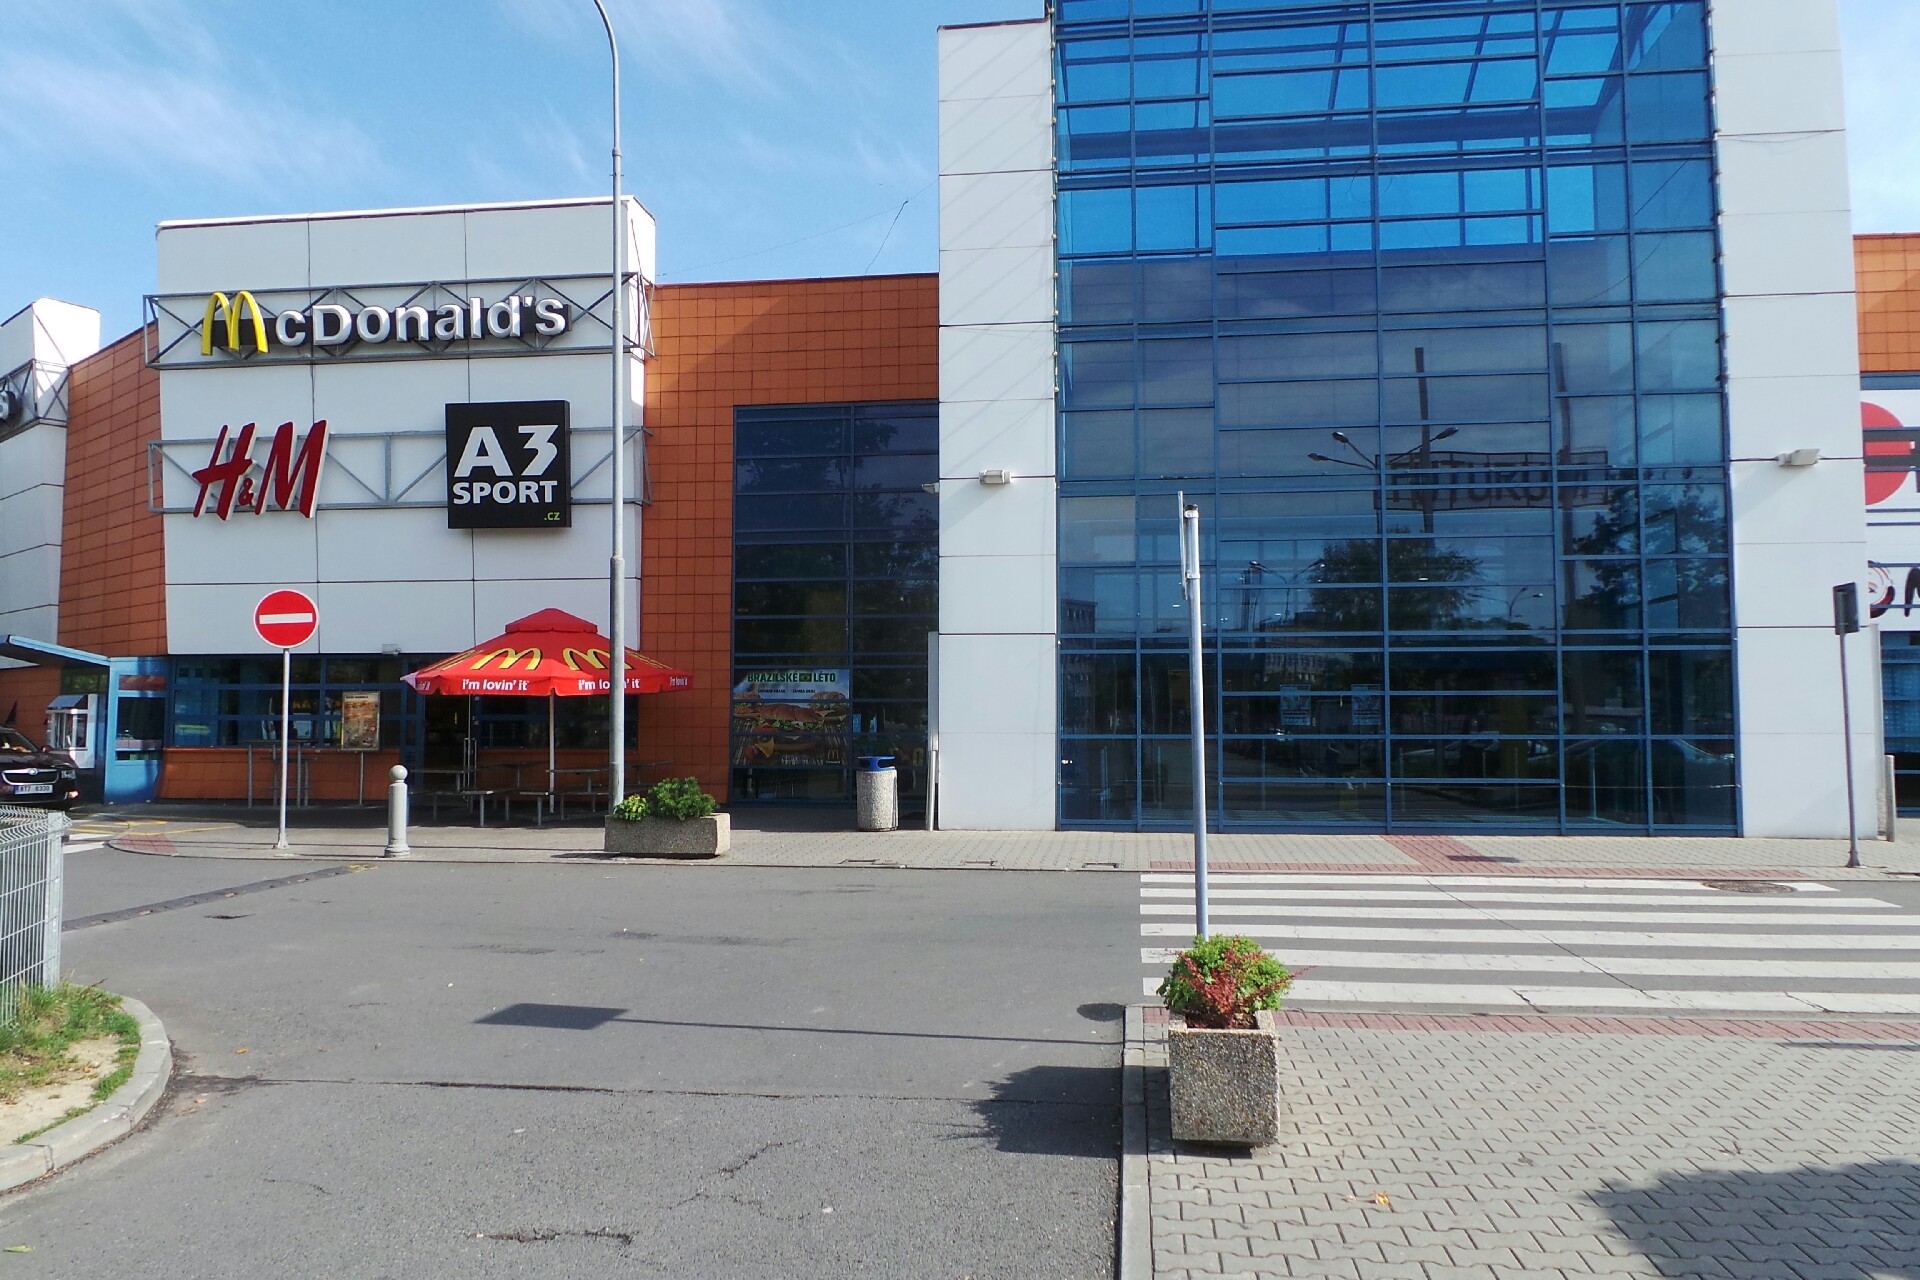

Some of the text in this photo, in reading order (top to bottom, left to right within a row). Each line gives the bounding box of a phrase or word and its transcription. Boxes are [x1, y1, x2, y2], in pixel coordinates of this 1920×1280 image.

[202, 290, 567, 356] McDonald's
[192, 420, 329, 521] H&M
[452, 480, 558, 505] SPORT
[462, 679, 528, 691] i'm lovin' it
[631, 678, 640, 689] it
[813, 671, 836, 682] LÉTO
